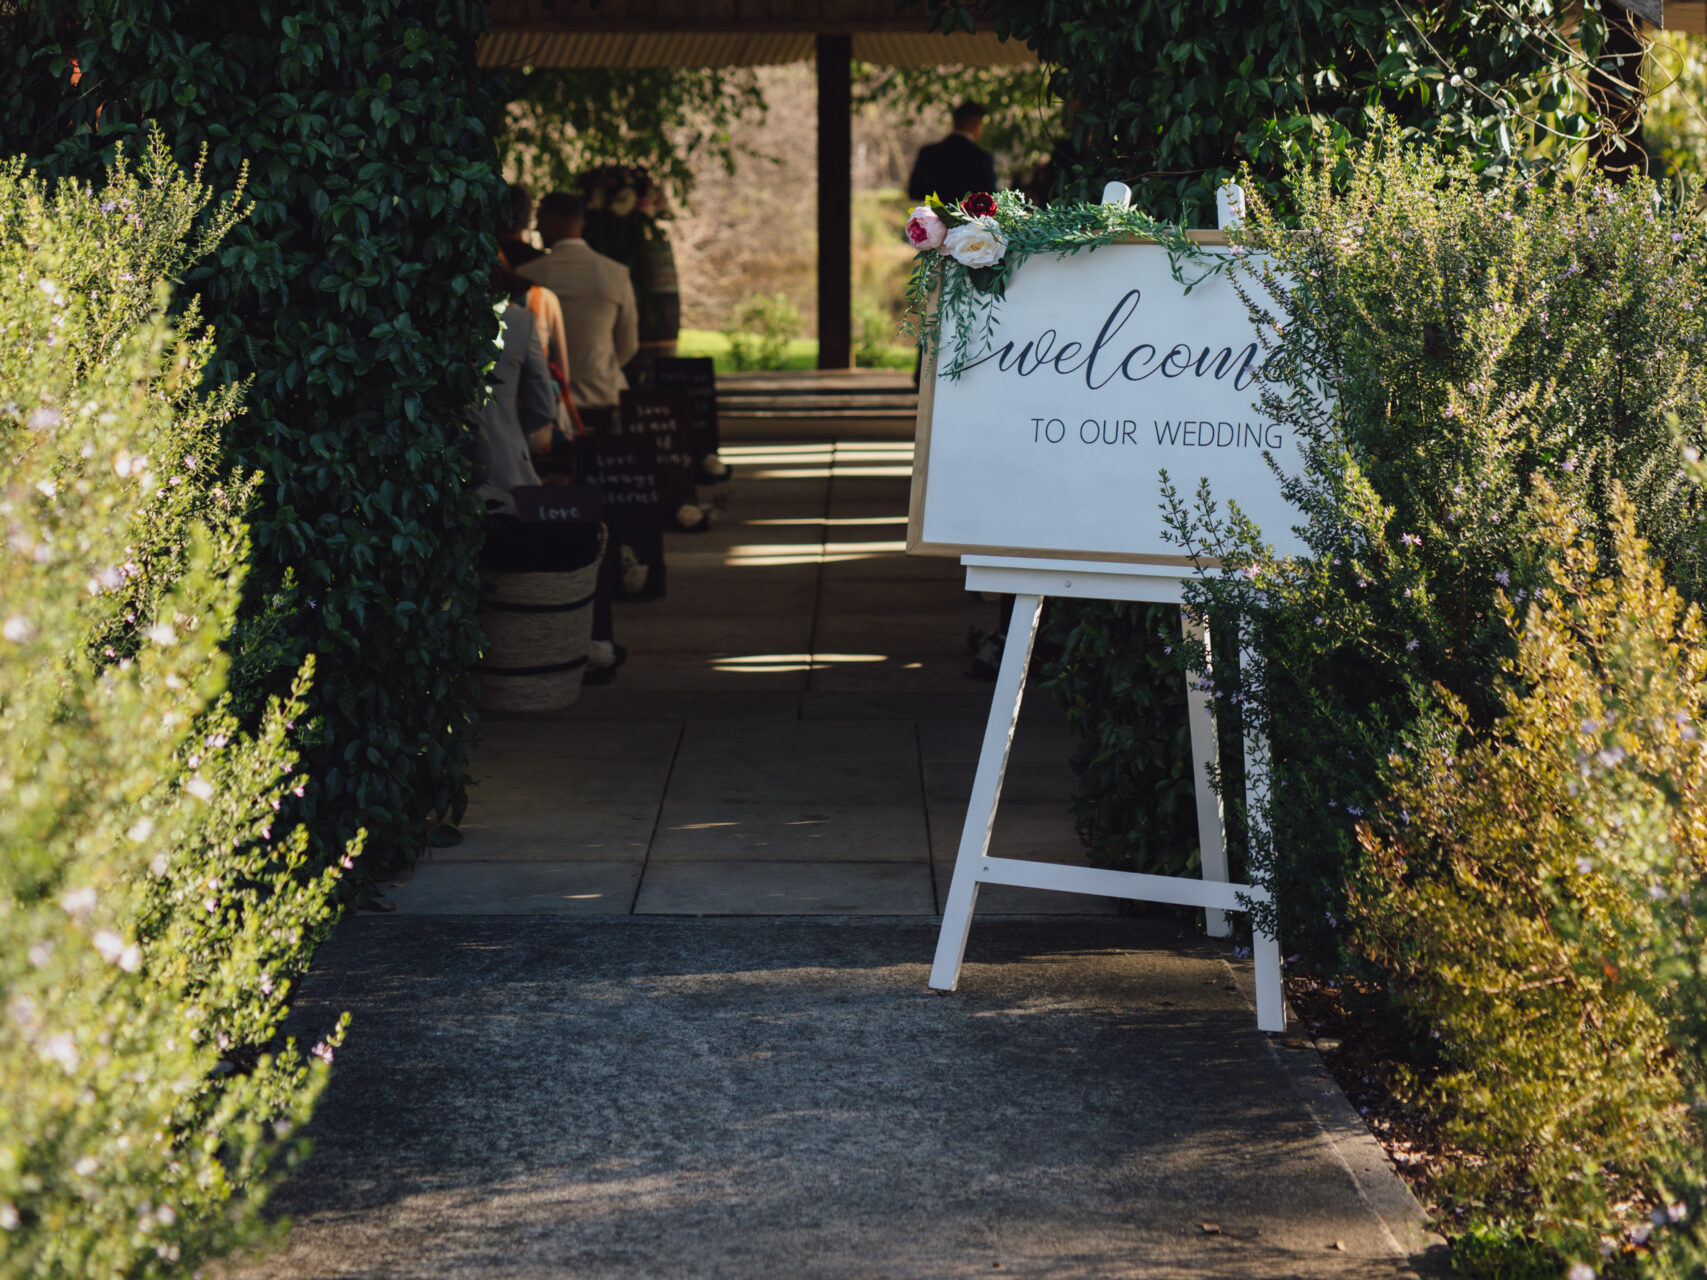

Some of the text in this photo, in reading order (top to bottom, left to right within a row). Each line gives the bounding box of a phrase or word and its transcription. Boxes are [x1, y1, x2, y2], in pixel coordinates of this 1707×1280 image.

[1031, 418, 1283, 449] TO OUR WEDDING
